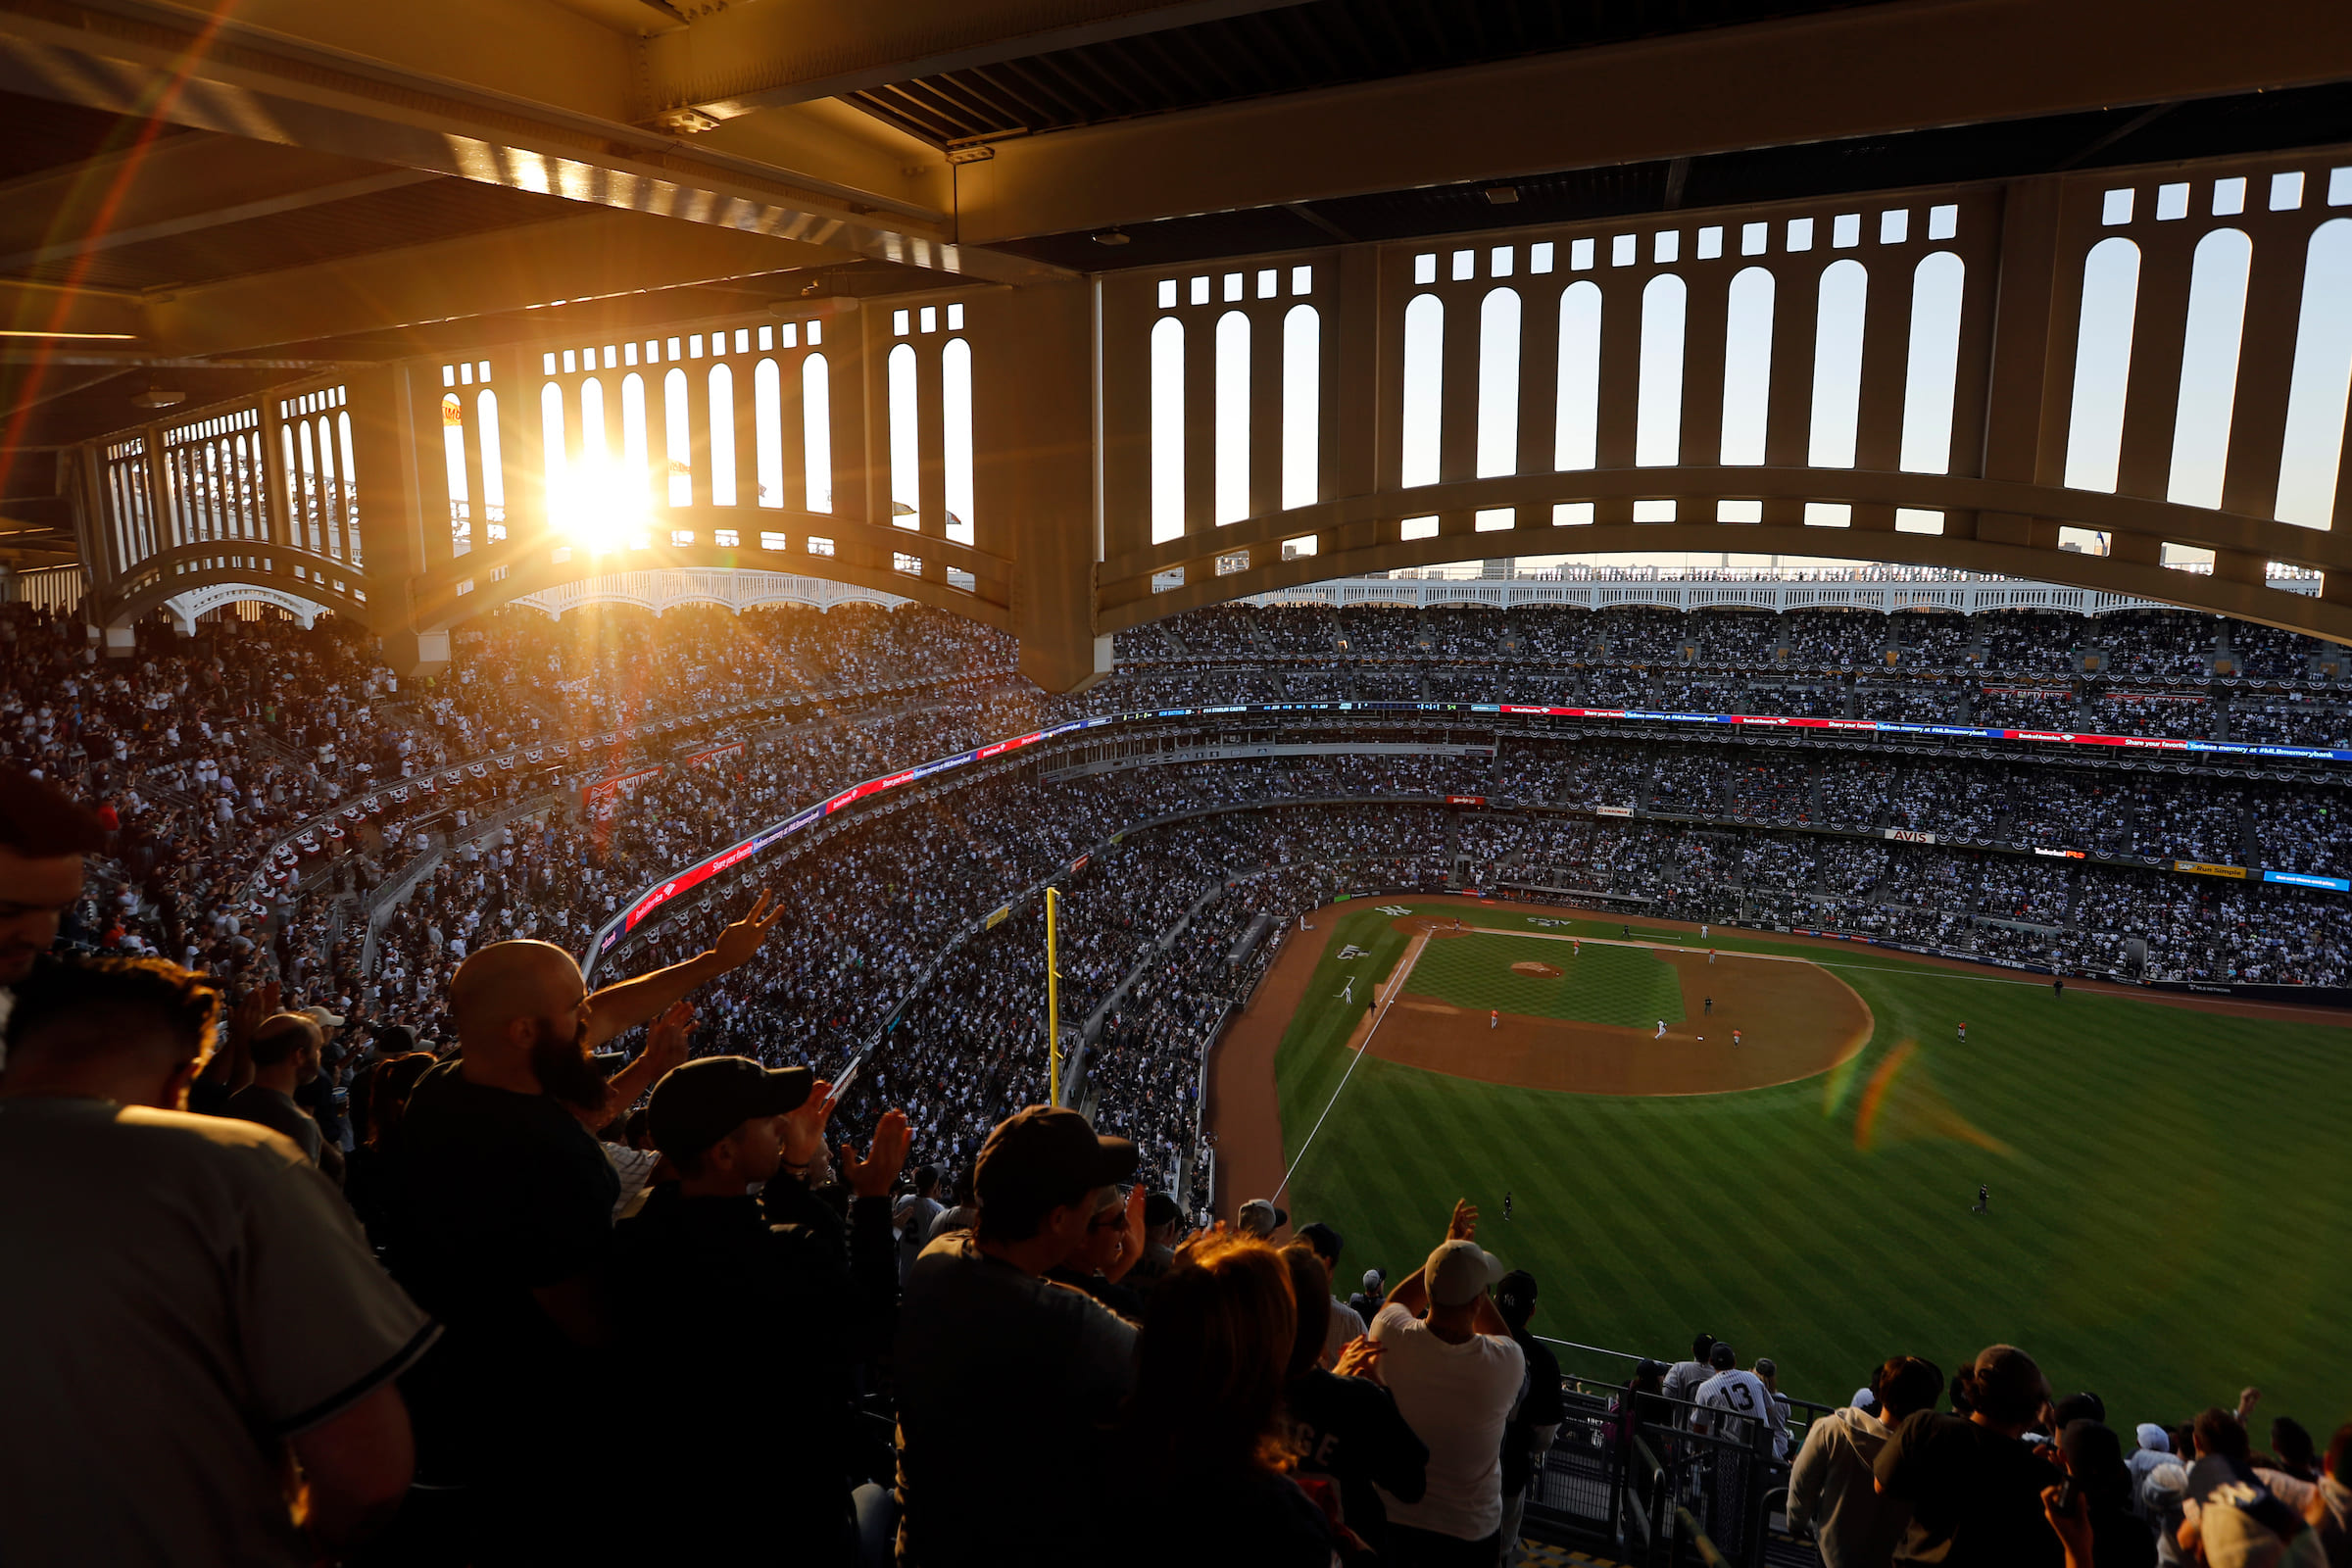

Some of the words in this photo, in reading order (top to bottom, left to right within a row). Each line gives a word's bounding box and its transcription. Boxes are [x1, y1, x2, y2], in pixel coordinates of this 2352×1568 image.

[1932, 727, 1987, 736] #MLBmemorybank
[2189, 742, 2217, 751] Yankees
[2219, 745, 2248, 754] memory
[2259, 748, 2333, 759] #MLBmemorybank
[1893, 831, 1927, 843] AVIS
[1720, 1383, 1754, 1411] 13
